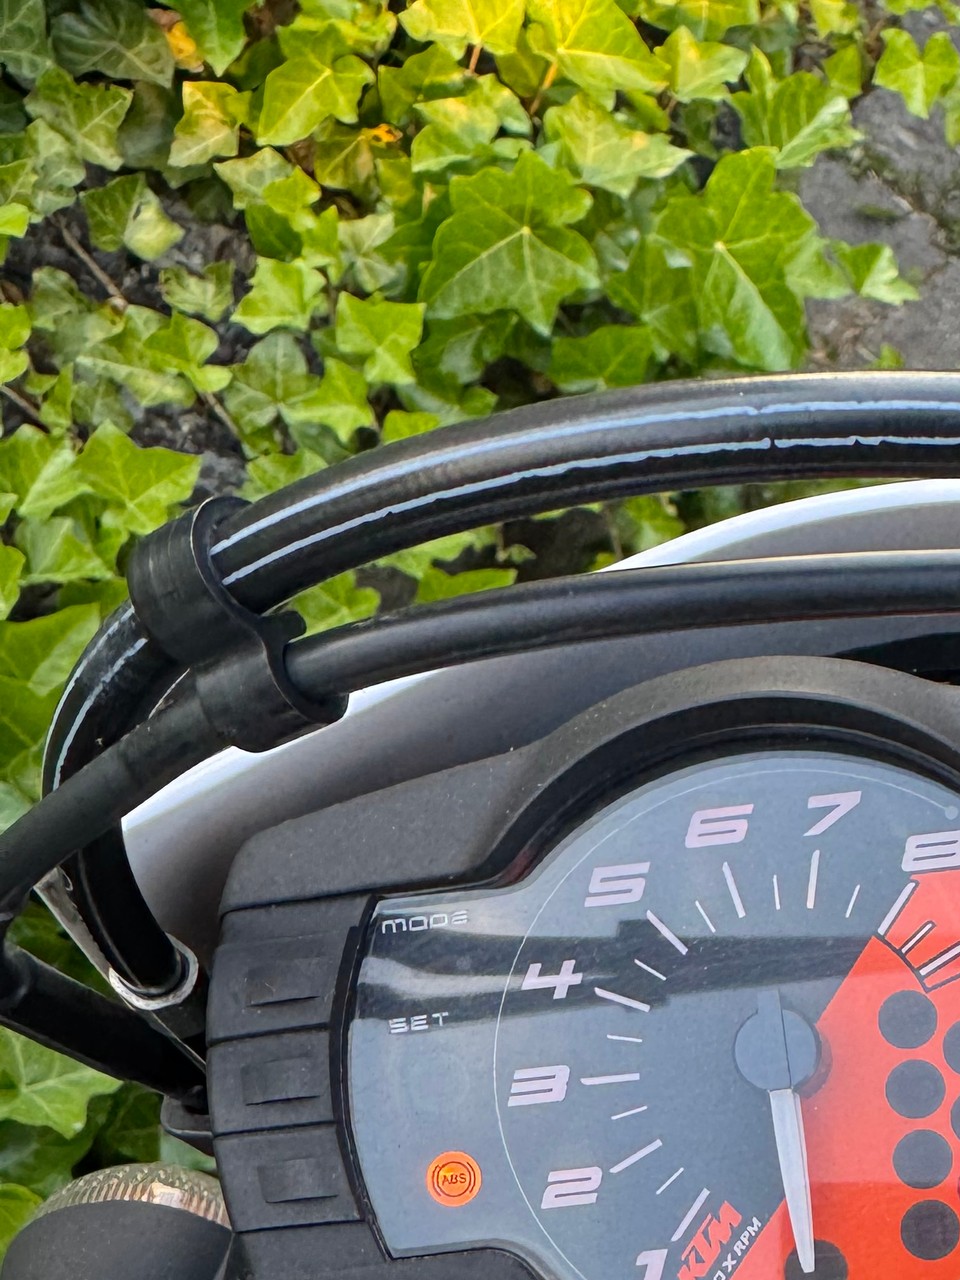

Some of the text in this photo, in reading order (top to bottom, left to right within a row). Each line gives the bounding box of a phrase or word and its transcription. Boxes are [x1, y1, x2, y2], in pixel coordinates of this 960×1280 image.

[685, 804, 755, 849] 6
[803, 790, 863, 836] 7
[585, 861, 650, 907] 5
[522, 960, 583, 999] 4
[388, 1011, 449, 1034] SET
[508, 1065, 569, 1107] 3
[442, 1173, 467, 1186] ABS
[541, 1166, 603, 1209] 2
[722, 1253, 738, 1273] X
[733, 1216, 762, 1257] RPM
